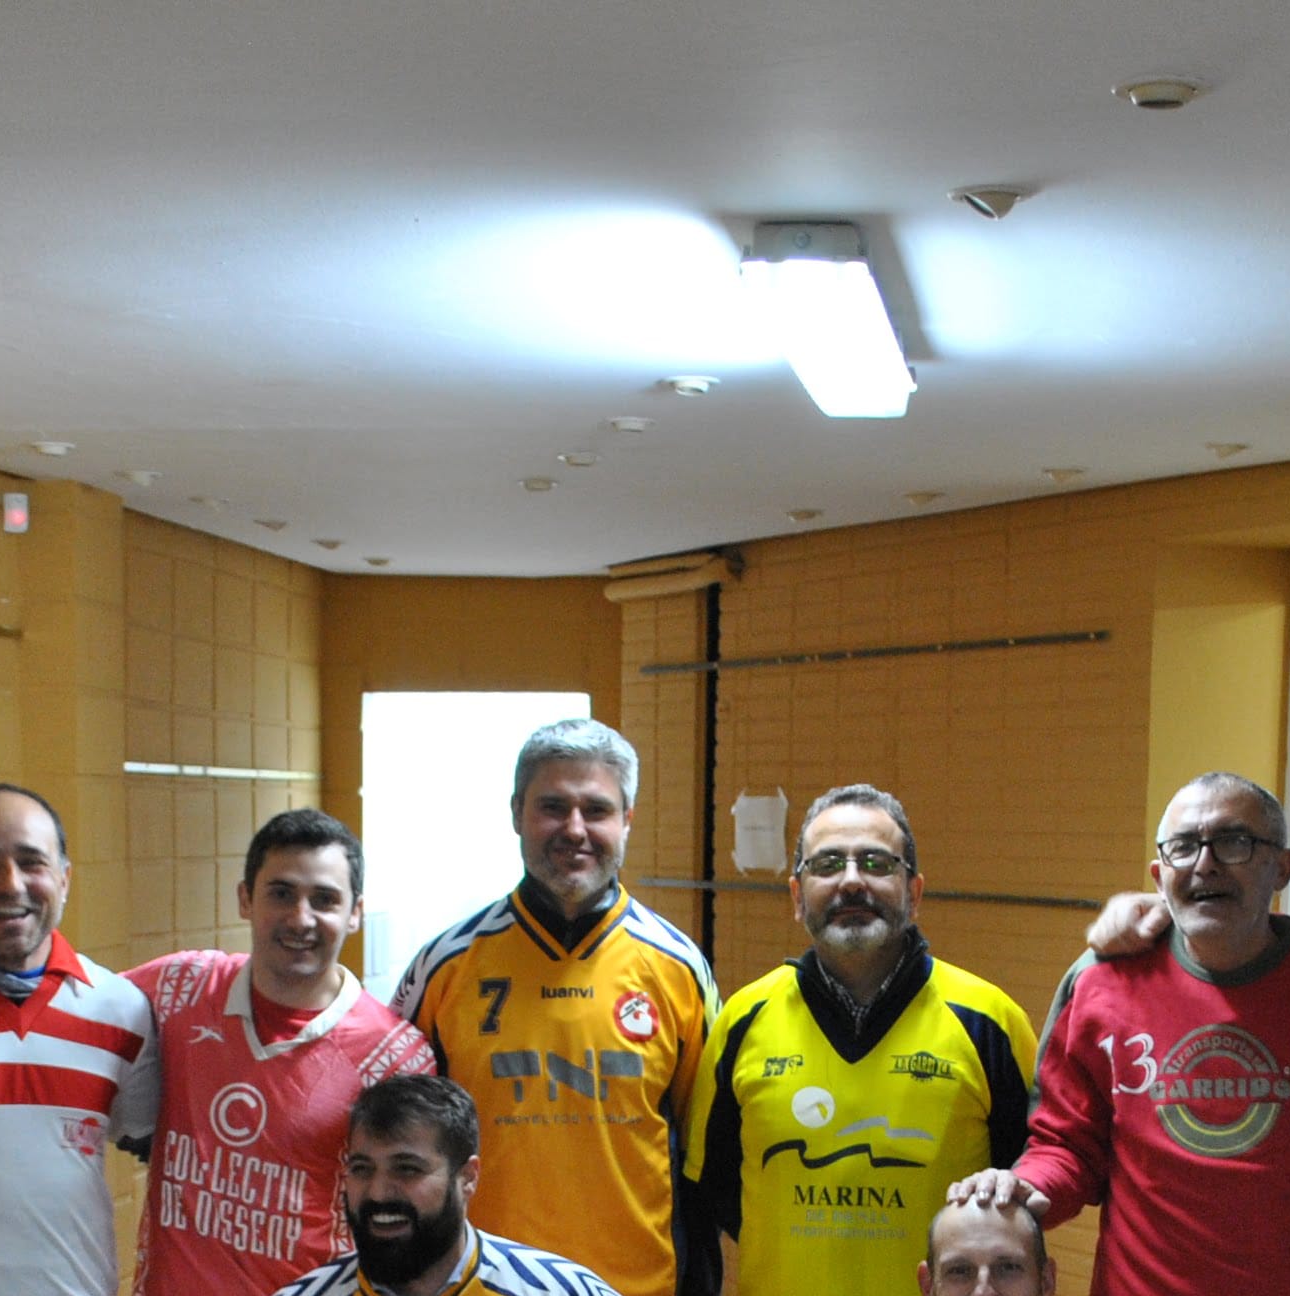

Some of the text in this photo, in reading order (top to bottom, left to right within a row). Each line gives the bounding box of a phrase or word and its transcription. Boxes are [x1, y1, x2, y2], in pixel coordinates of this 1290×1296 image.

[479, 977, 511, 1035] 7
[540, 985, 593, 999] luanvi
[490, 1050, 644, 1103] TNP
[1098, 1032, 1157, 1095] 13
[160, 1180, 187, 1230] DE
[794, 1185, 906, 1209] MARINA
